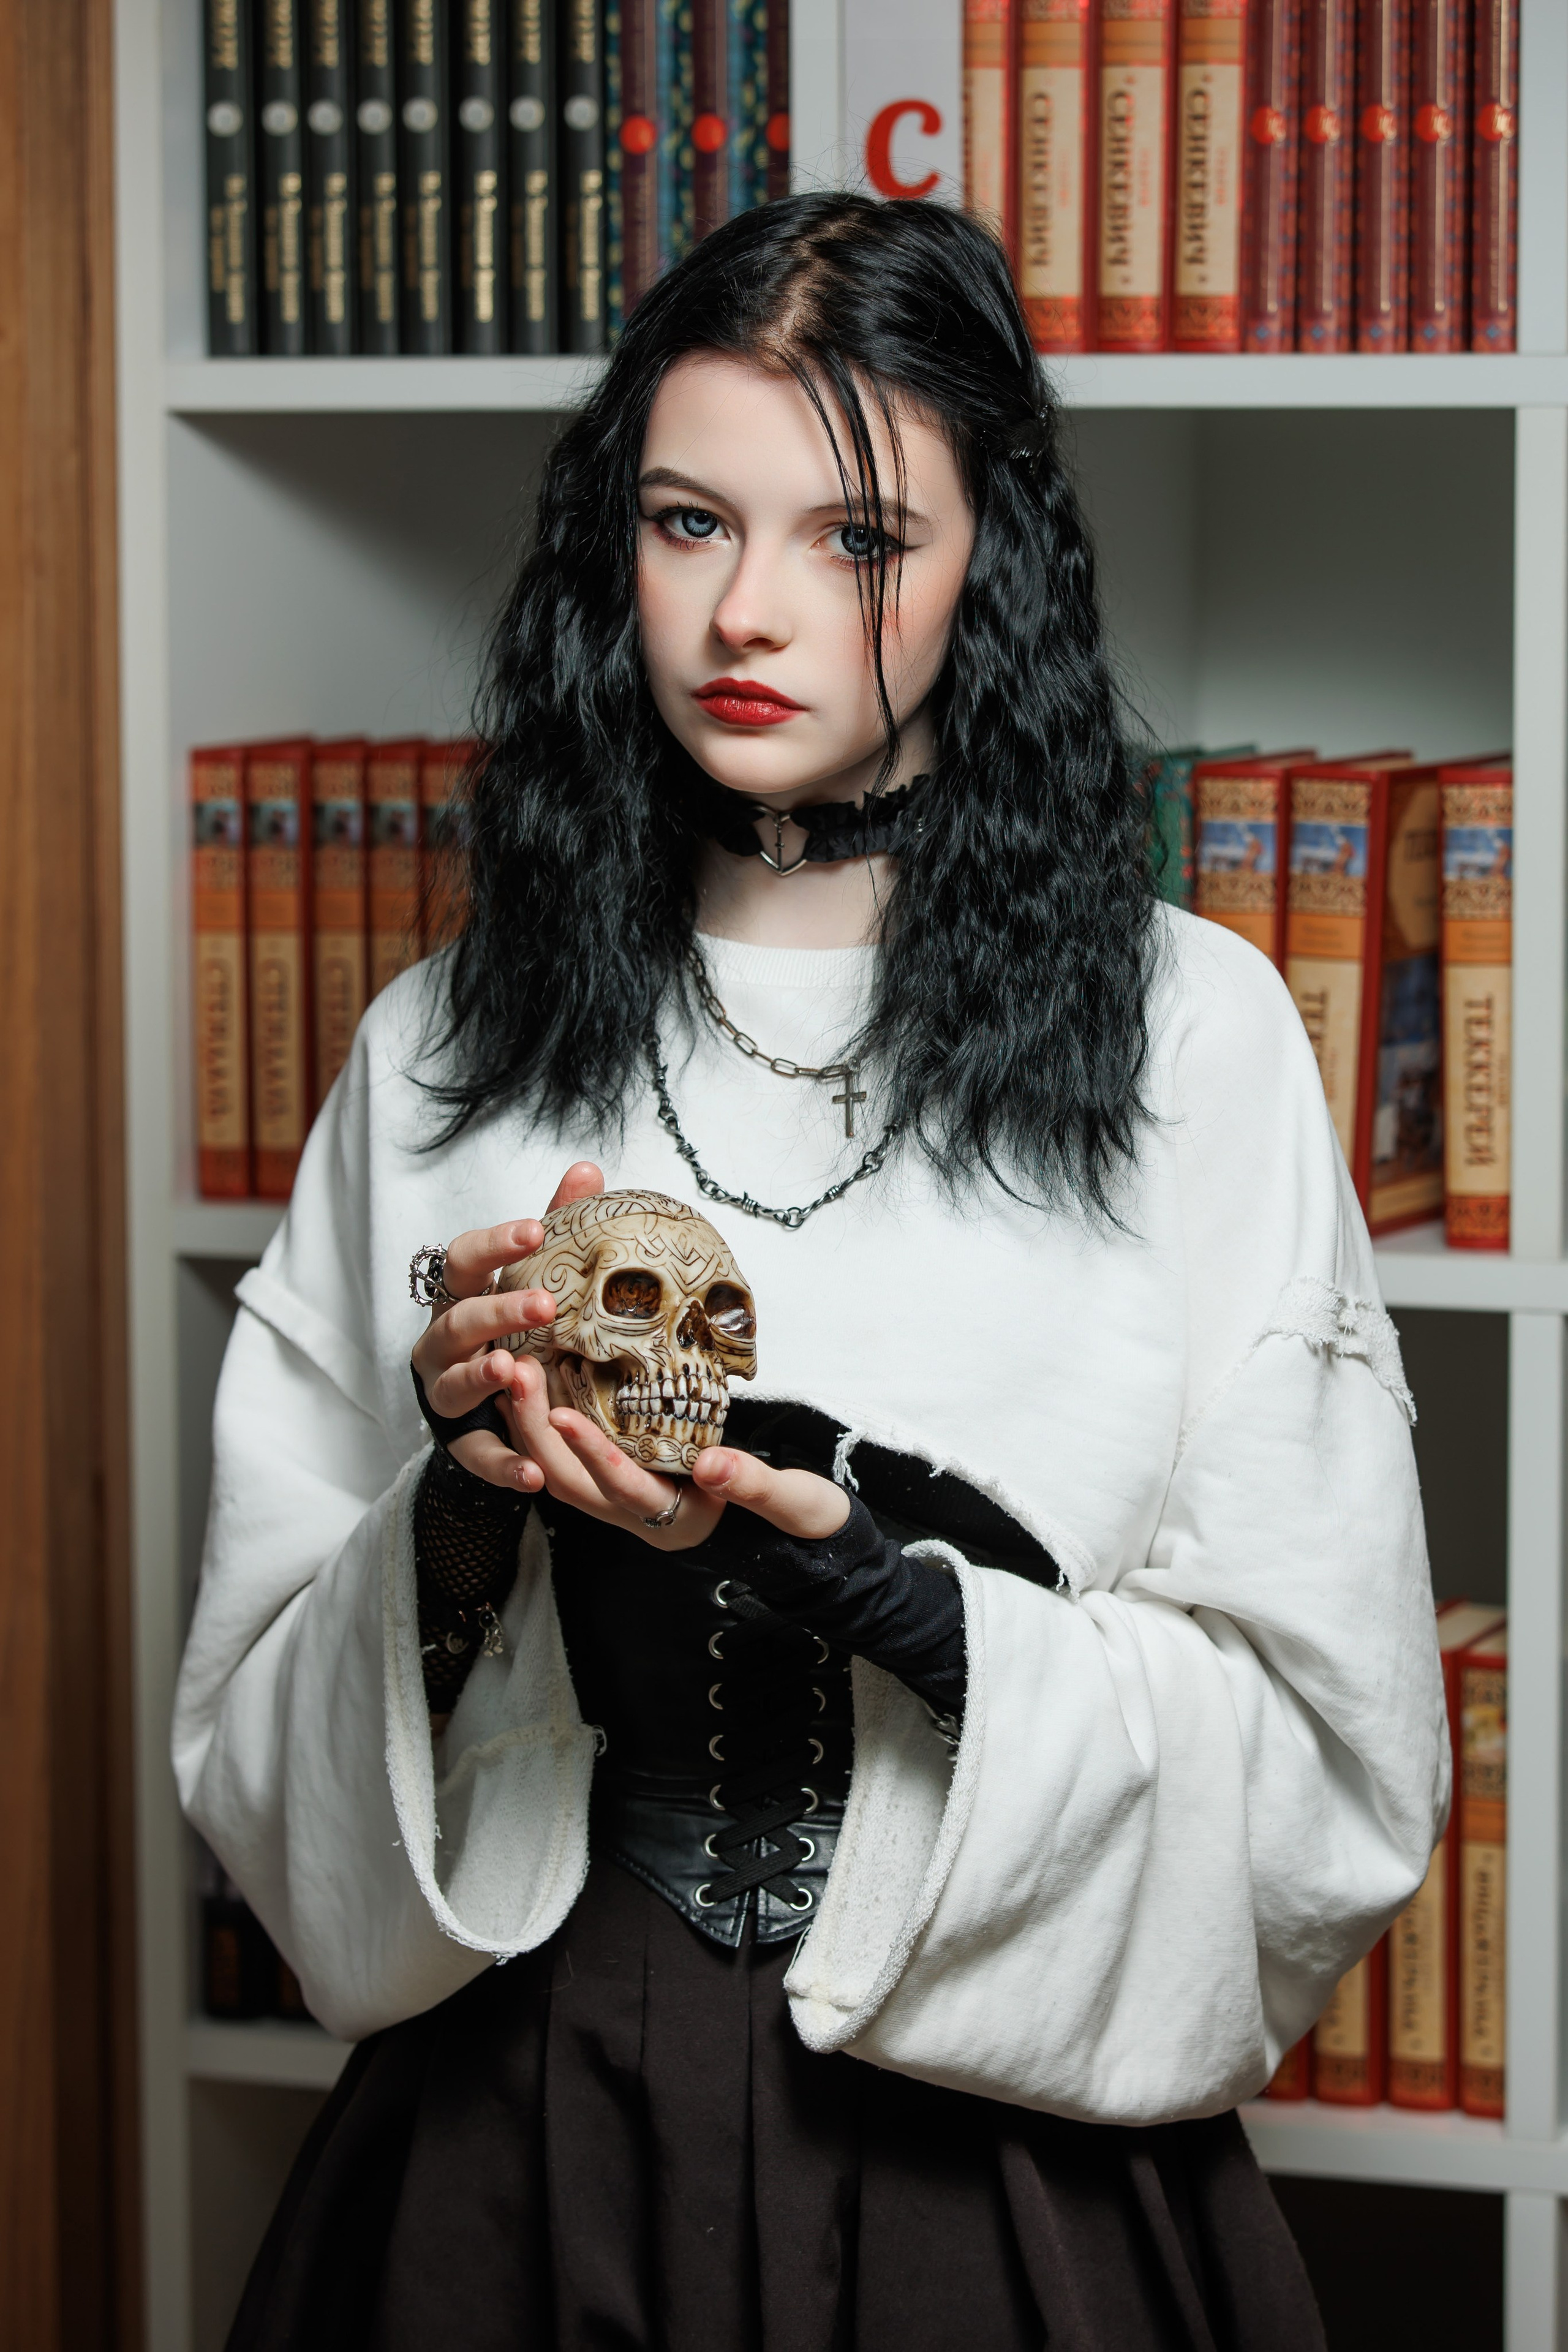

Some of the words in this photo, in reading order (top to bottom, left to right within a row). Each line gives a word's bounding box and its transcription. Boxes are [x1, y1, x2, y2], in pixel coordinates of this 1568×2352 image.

[1026, 90, 1053, 267] СЕНКЕВИЧ
[1106, 89, 1133, 266] СЕНКЕВИЧ
[1183, 88, 1210, 266] СЕНКЕВИЧ
[1463, 993, 1493, 1170] ТЕККЕРЕЙ
